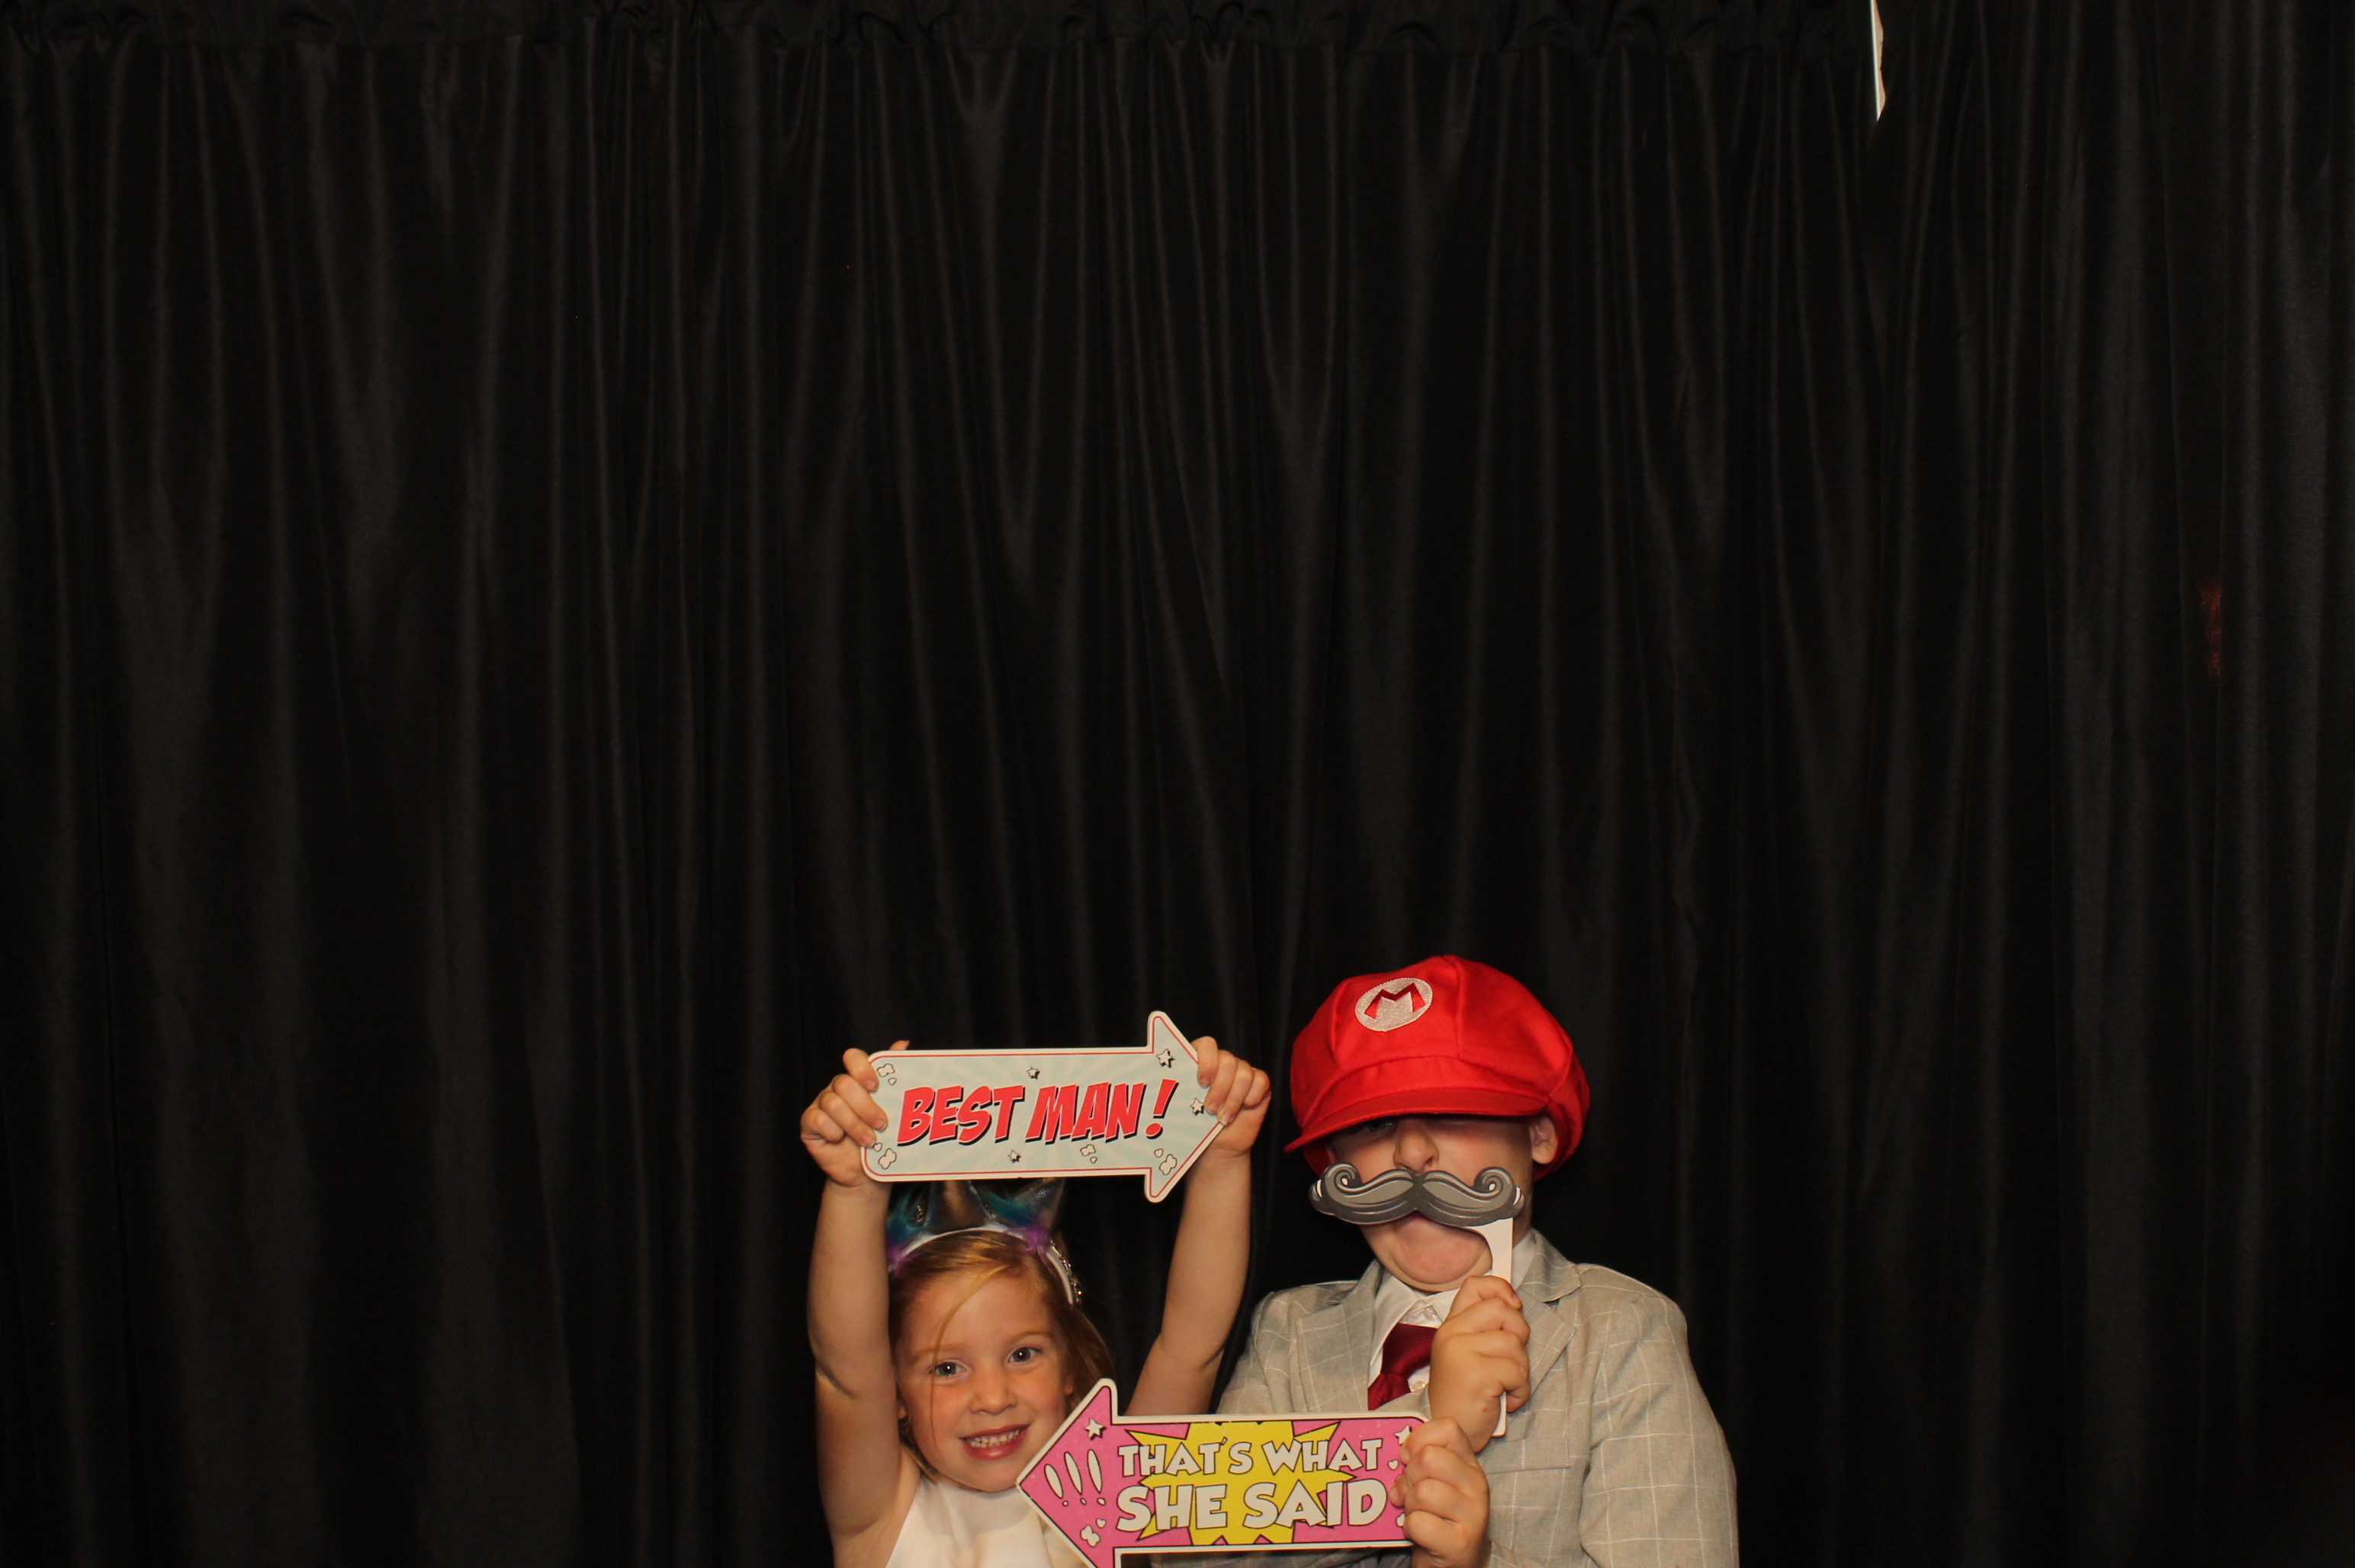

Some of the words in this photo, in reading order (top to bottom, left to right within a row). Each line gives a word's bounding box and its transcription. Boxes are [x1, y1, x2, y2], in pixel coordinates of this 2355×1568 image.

[1364, 982, 1425, 1019] M
[897, 1085, 1025, 1145] BEST
[1025, 1079, 1179, 1144] MAN!
[1117, 1437, 1252, 1476] THAT'S
[1261, 1438, 1383, 1475] WHAT
[1116, 1484, 1228, 1531] SHE
[1242, 1479, 1387, 1528] SAID
